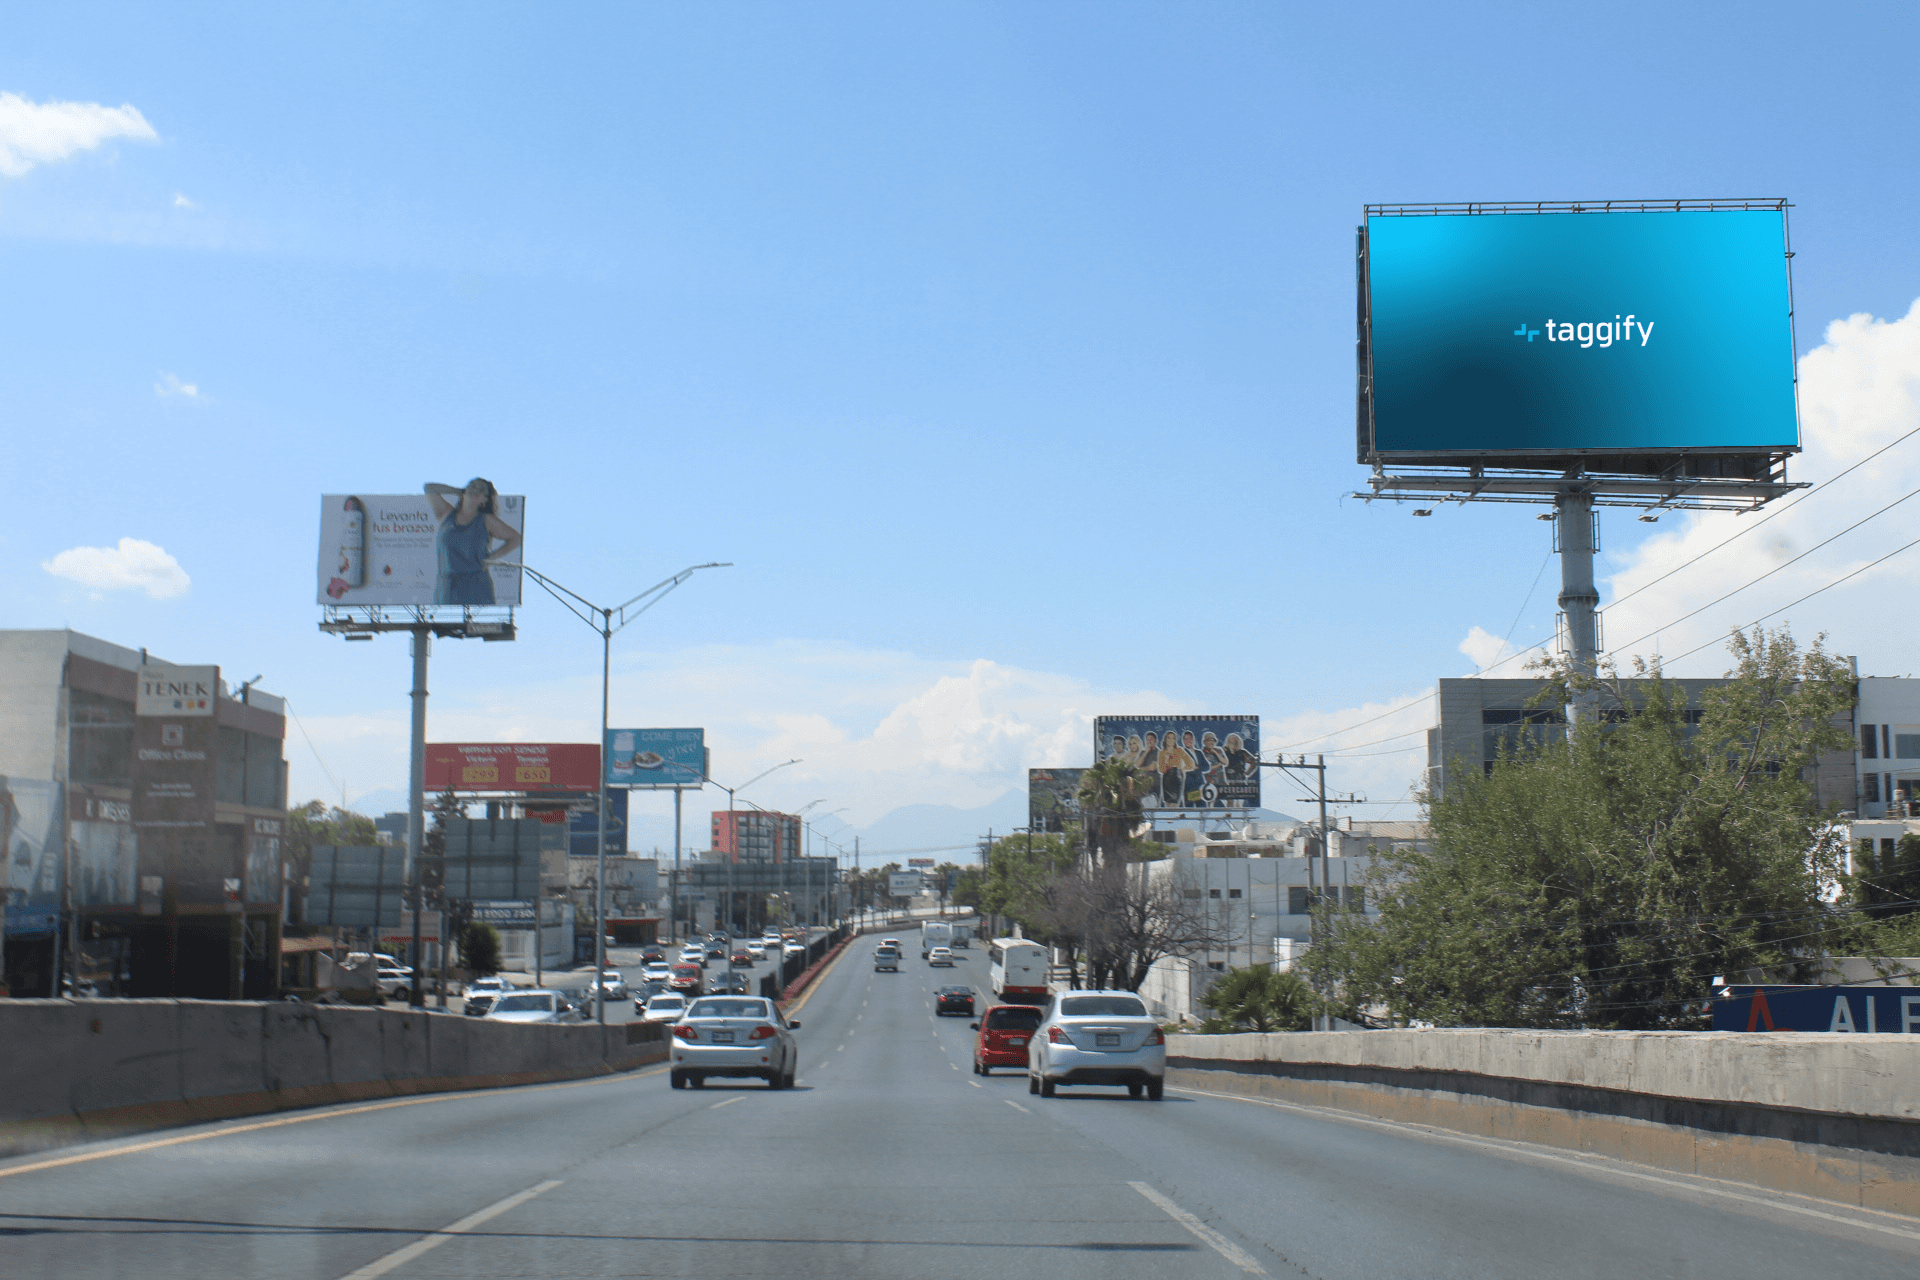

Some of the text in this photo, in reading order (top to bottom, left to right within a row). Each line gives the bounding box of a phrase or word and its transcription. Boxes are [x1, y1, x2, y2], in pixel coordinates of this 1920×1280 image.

[1545, 314, 1655, 348] taggify
[380, 509, 428, 521] Levanta
[372, 521, 435, 533] tus brazos
[143, 681, 209, 696] TENEK
[1202, 782, 1215, 800] 6
